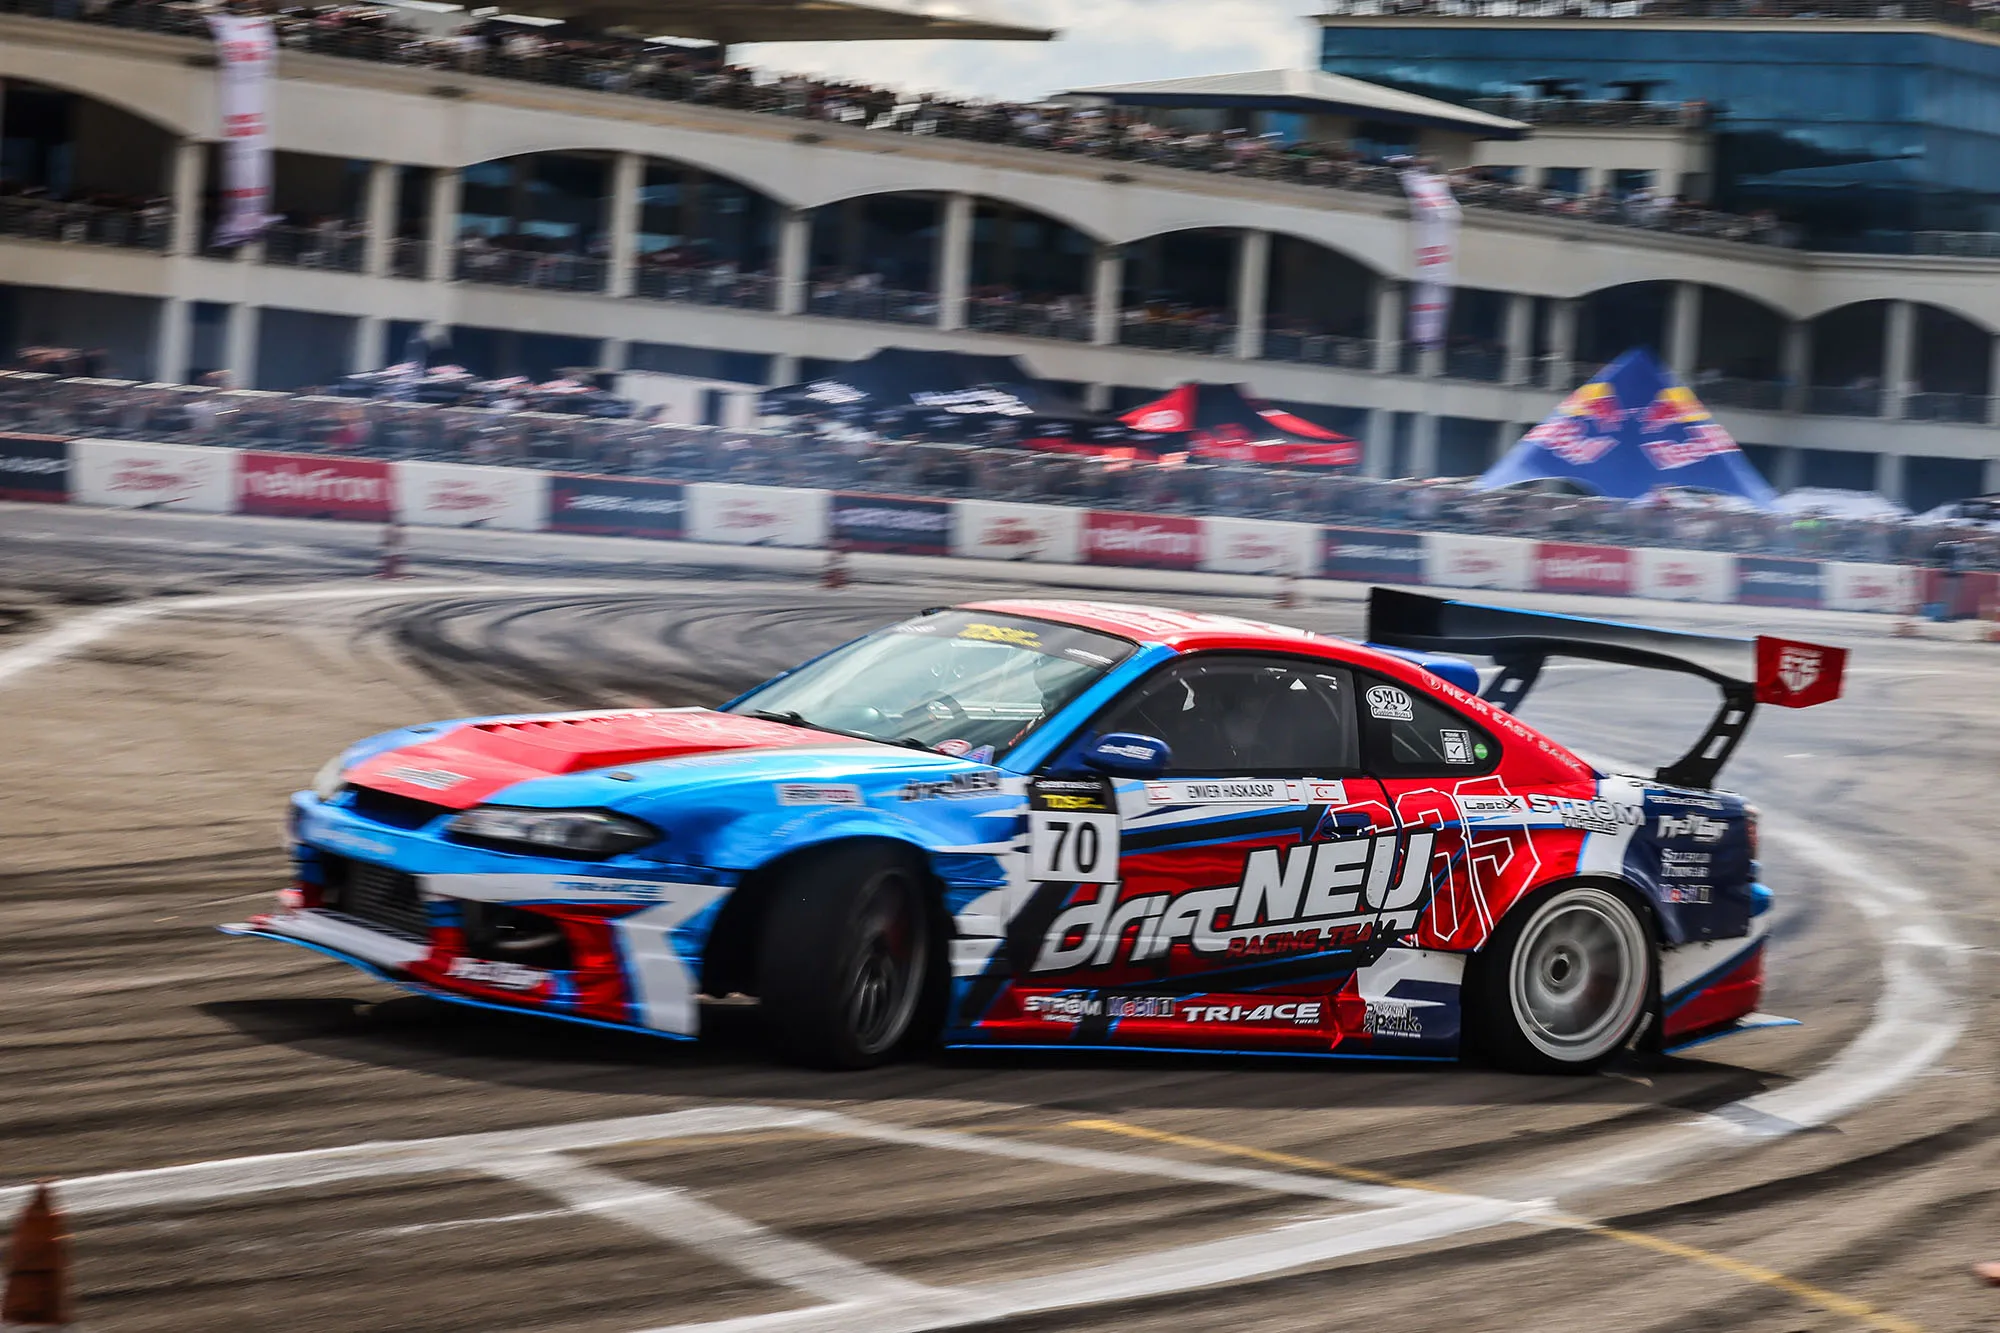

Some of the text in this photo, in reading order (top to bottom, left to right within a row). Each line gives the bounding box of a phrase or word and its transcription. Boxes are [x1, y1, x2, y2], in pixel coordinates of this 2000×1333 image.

[1373, 690, 1406, 704] SMD
[1442, 685, 1489, 716] NEAR
[1492, 712, 1536, 742] EAST
[1465, 798, 1521, 811] LastiX
[1045, 821, 1099, 874] 70
[1232, 833, 1435, 927] NEU
[1226, 928, 1321, 959] RACING
[1182, 1002, 1321, 1023] TRI-ACE
